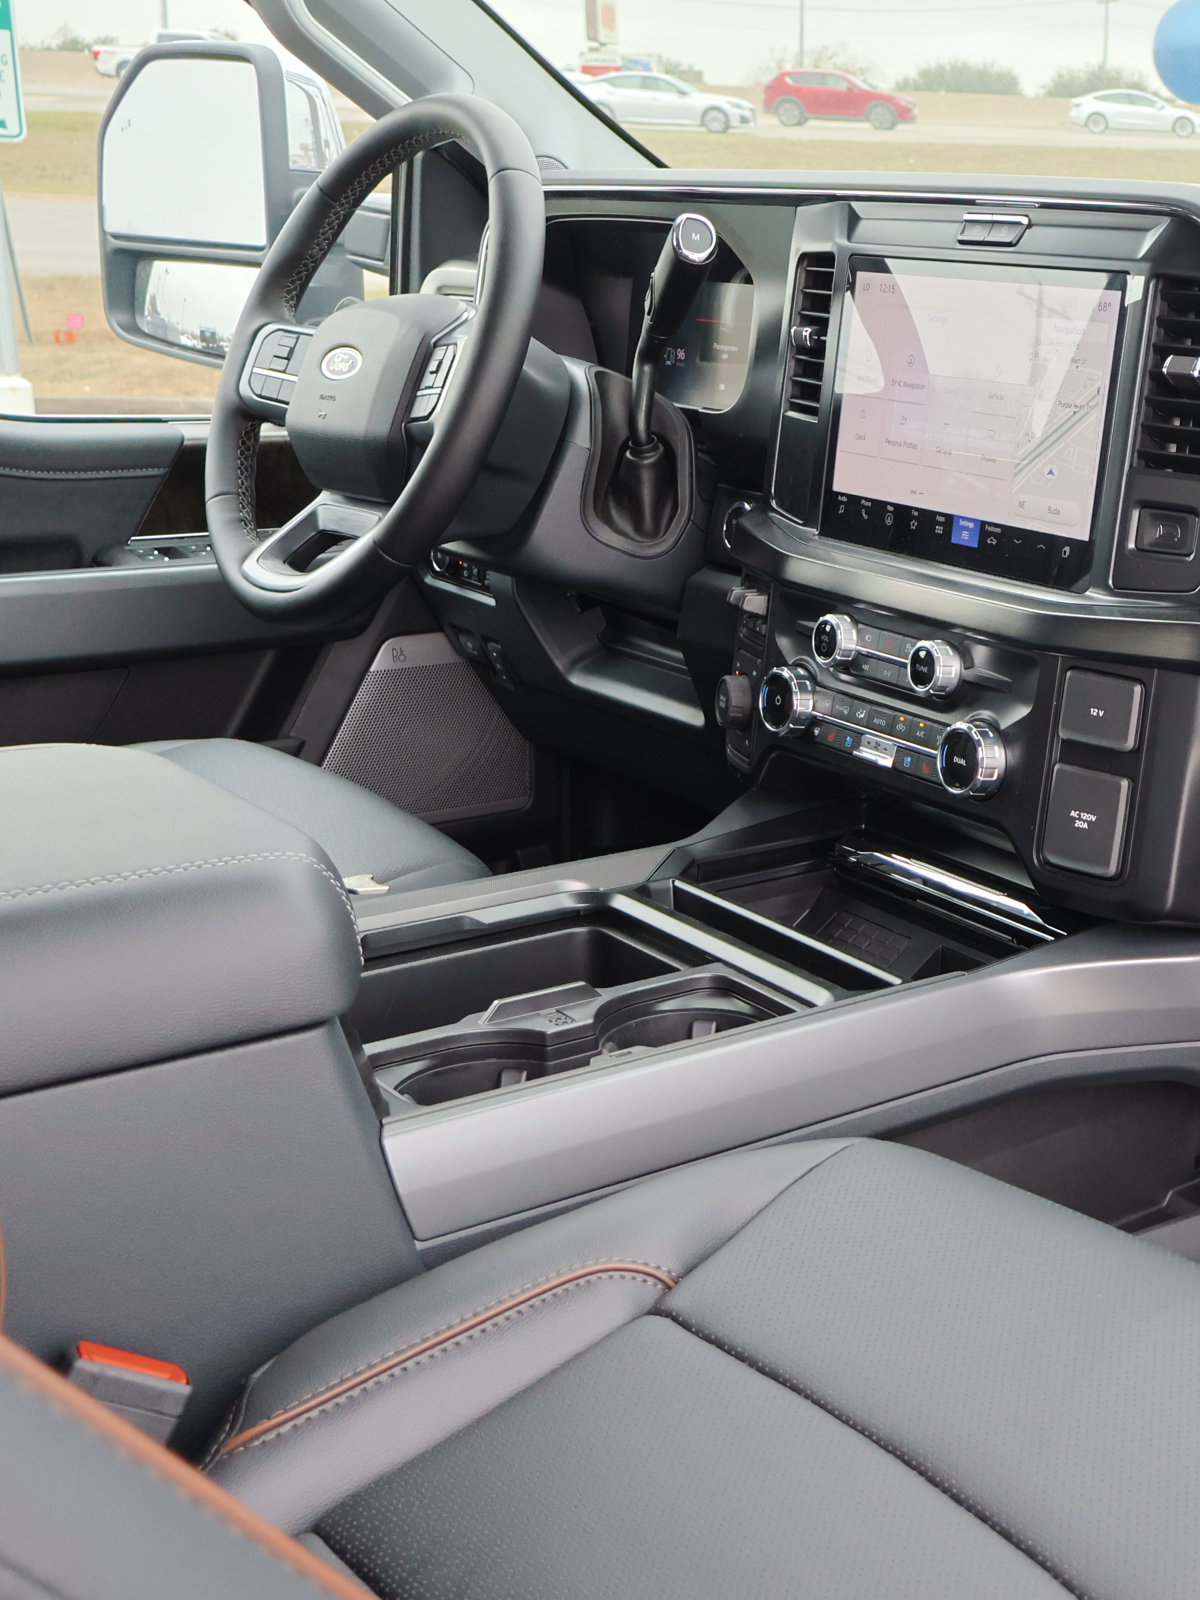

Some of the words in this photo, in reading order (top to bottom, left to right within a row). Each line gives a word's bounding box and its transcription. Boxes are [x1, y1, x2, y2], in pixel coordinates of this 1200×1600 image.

[692, 232, 700, 241] M
[880, 283, 896, 293] 12:15
[676, 348, 685, 360] 96
[916, 664, 928, 673] TUNE
[873, 718, 886, 726] AUTO
[953, 757, 966, 766] DUAL
[1070, 810, 1080, 818] AC
[1080, 812, 1097, 822] 120V
[1074, 820, 1088, 829] 20A
